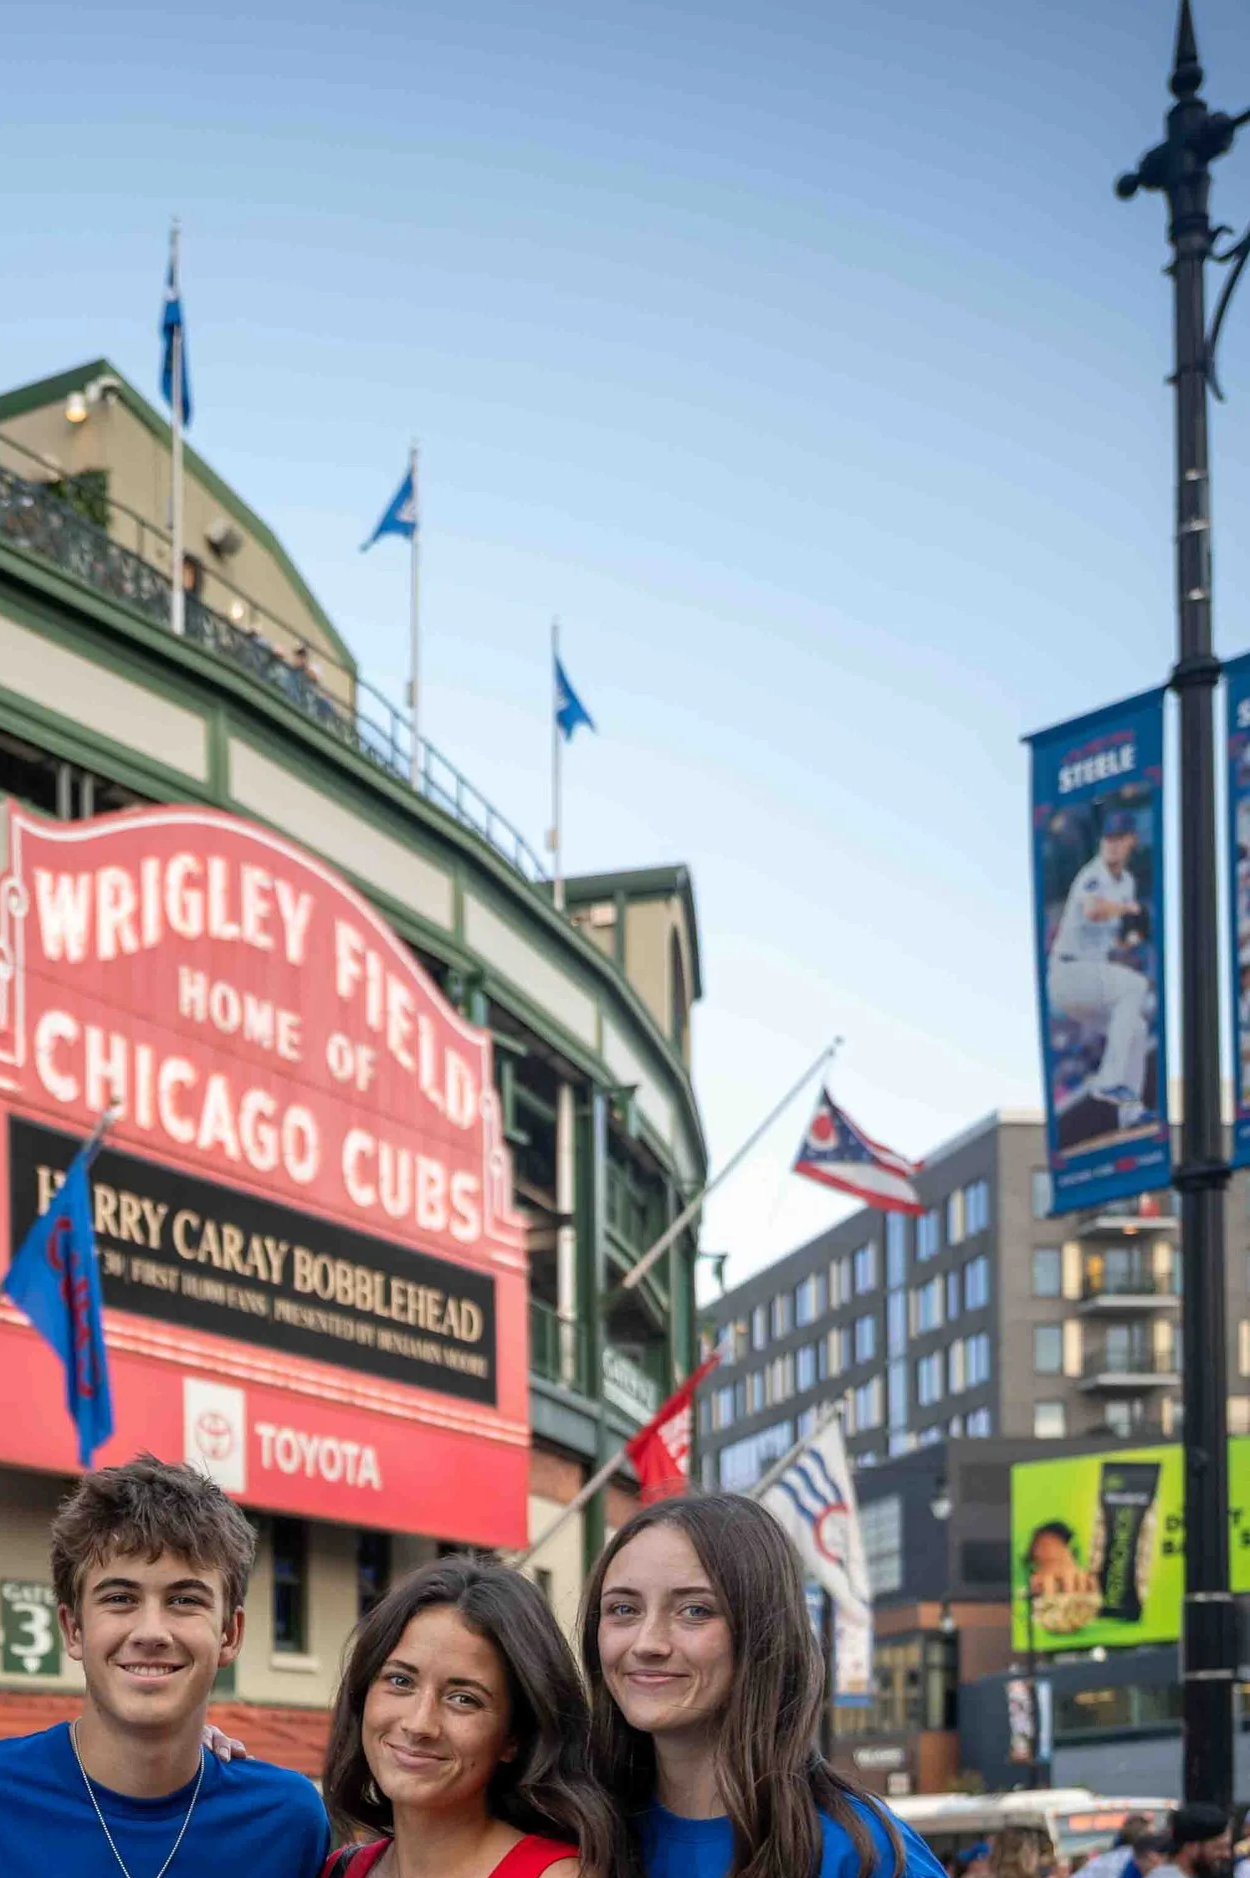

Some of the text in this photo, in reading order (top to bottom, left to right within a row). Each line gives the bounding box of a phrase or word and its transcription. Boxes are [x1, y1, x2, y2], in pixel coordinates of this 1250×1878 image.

[1058, 743, 1136, 794] STEELE
[34, 853, 478, 1130] WRIGLEY FIELD
[178, 967, 380, 1093] HOME OF
[35, 1011, 482, 1243] CHICAGO CUBS
[36, 1164, 484, 1343] HRRY CARAY BOBBLEHEAD
[254, 1422, 382, 1490] TOYOTA
[10, 1601, 54, 1657] 3
